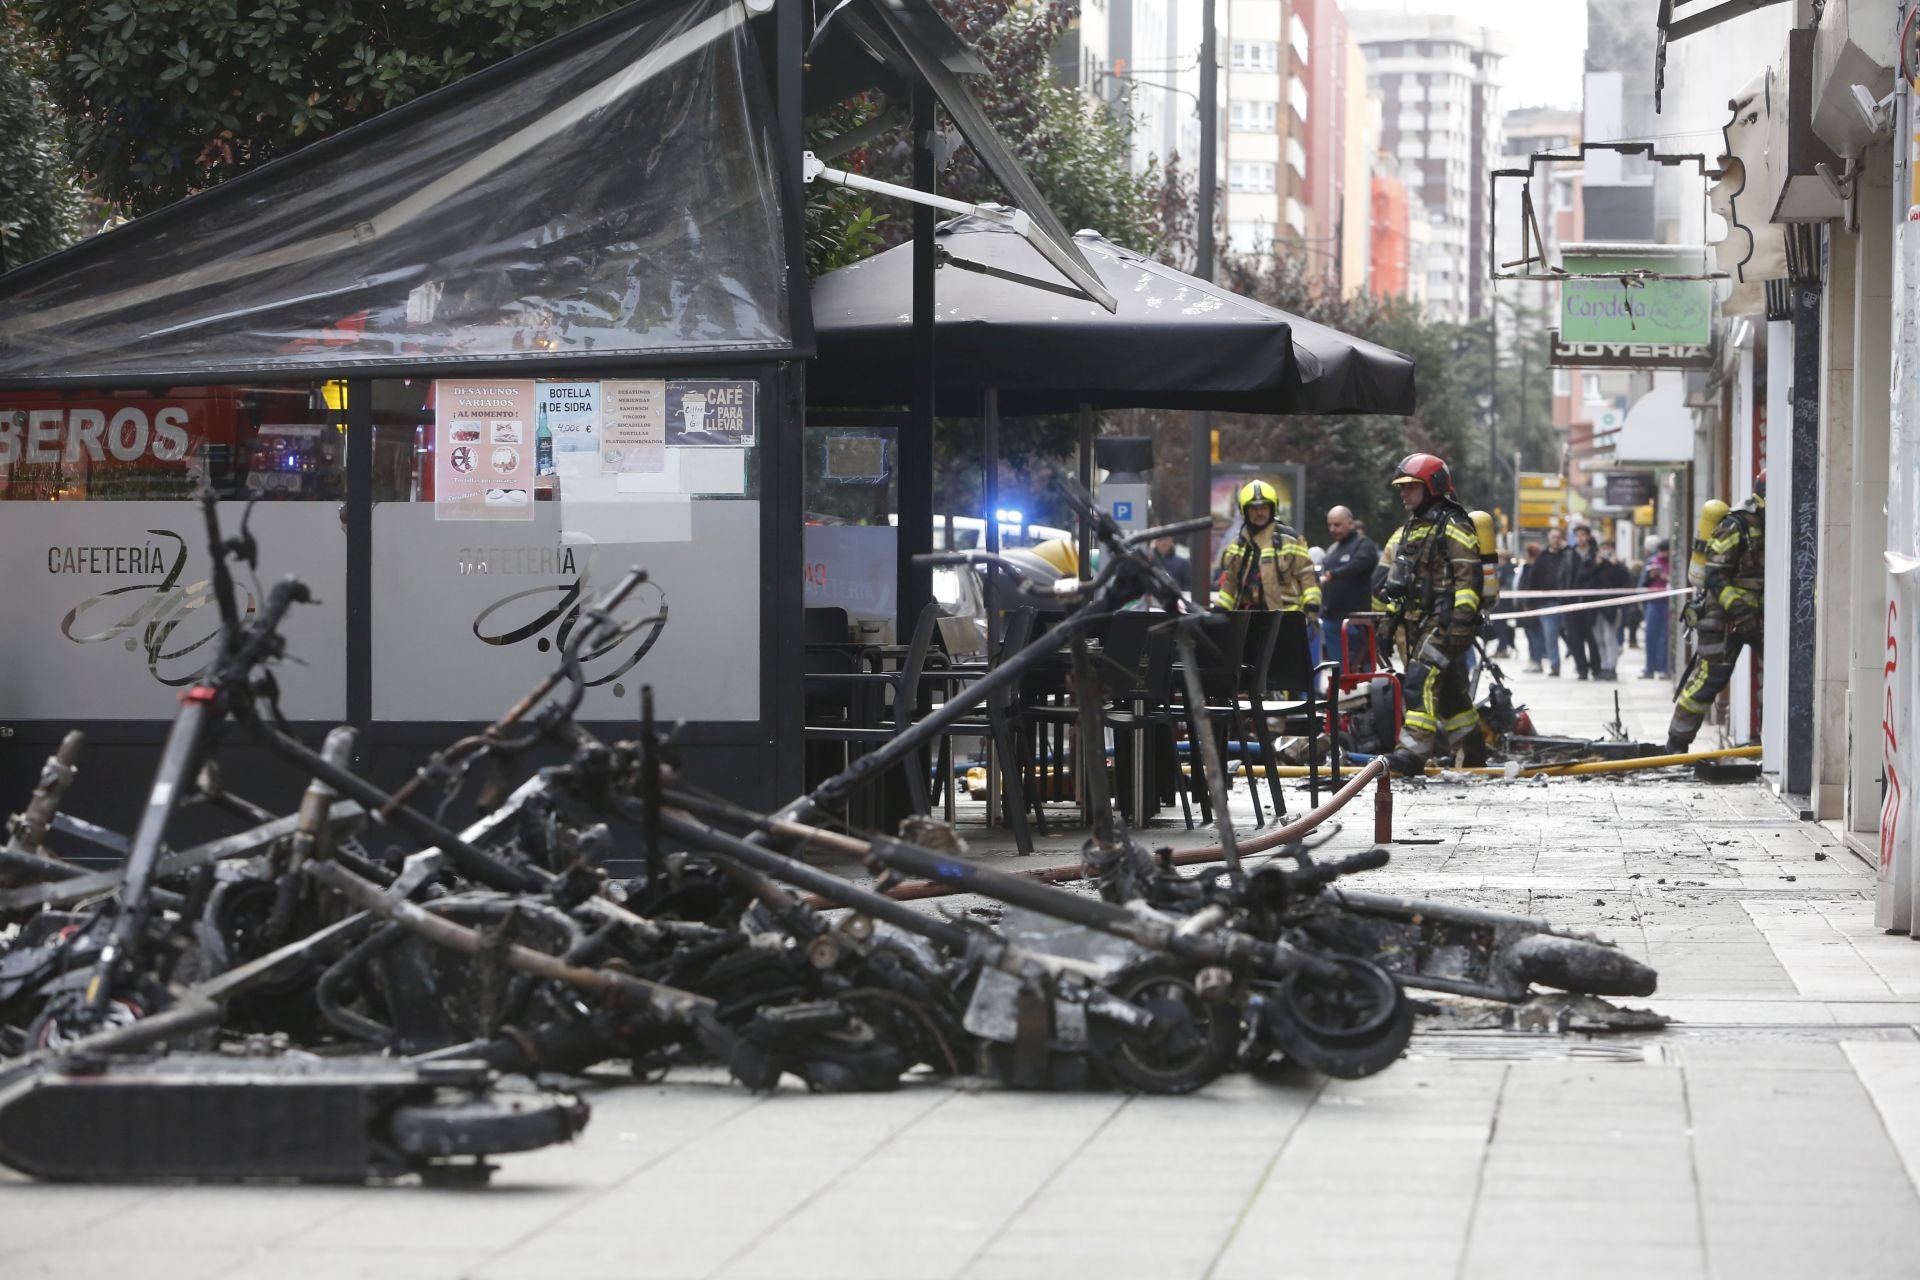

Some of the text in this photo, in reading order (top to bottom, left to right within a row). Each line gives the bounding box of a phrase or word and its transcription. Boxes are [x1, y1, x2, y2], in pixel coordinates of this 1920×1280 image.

[454, 387, 519, 395] DESAYUNOS
[549, 388, 591, 398] BOTELLA
[707, 384, 743, 405] CAFÉ
[459, 399, 514, 407] VARIADOS
[549, 403, 592, 412] DE SIDRA
[717, 406, 743, 419] PARA
[706, 419, 743, 430] LLEVAR
[1118, 505, 1128, 518] P
[47, 540, 165, 574] CAFETERÍA
